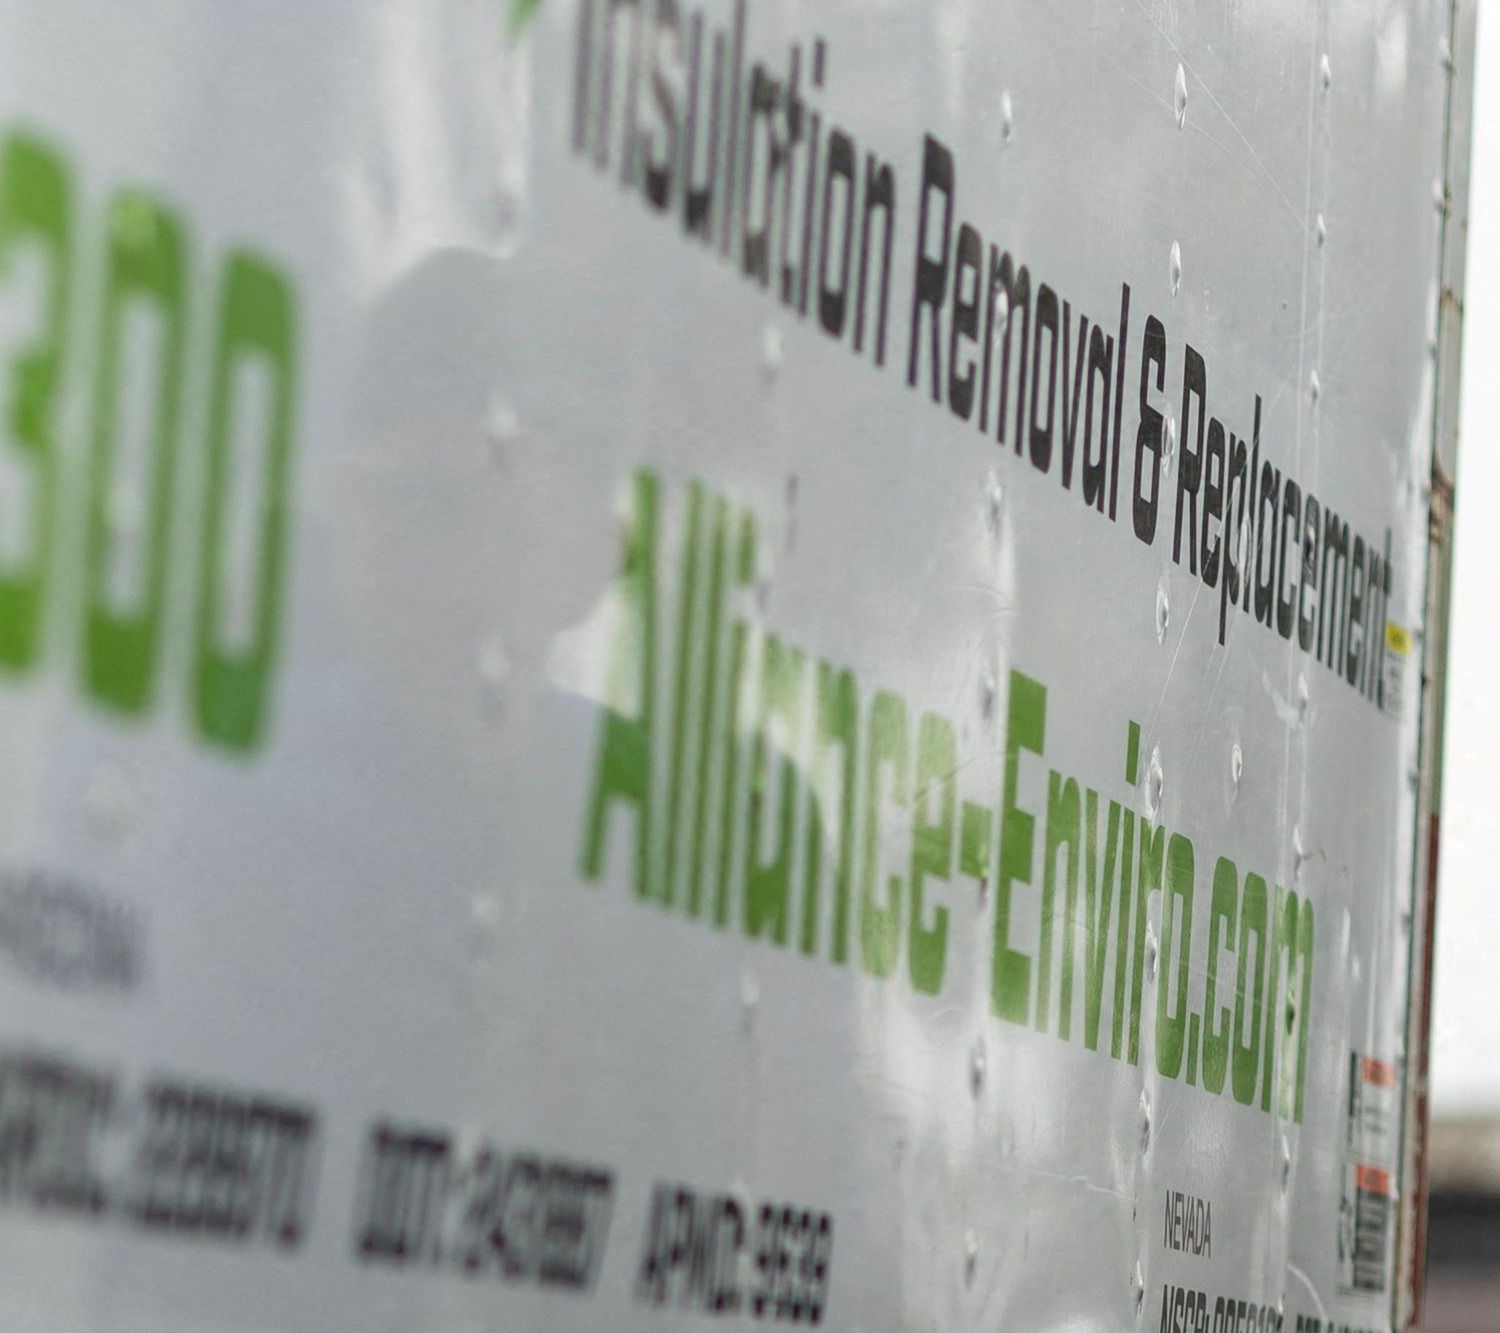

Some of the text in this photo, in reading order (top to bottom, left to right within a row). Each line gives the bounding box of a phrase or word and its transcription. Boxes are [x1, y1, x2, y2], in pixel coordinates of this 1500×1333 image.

[570, 0, 1393, 712] Insulation Removal & Replacement
[576, 465, 1316, 1125] Alliance-Enviro.com
[1163, 1189, 1212, 1259] NEVADA
